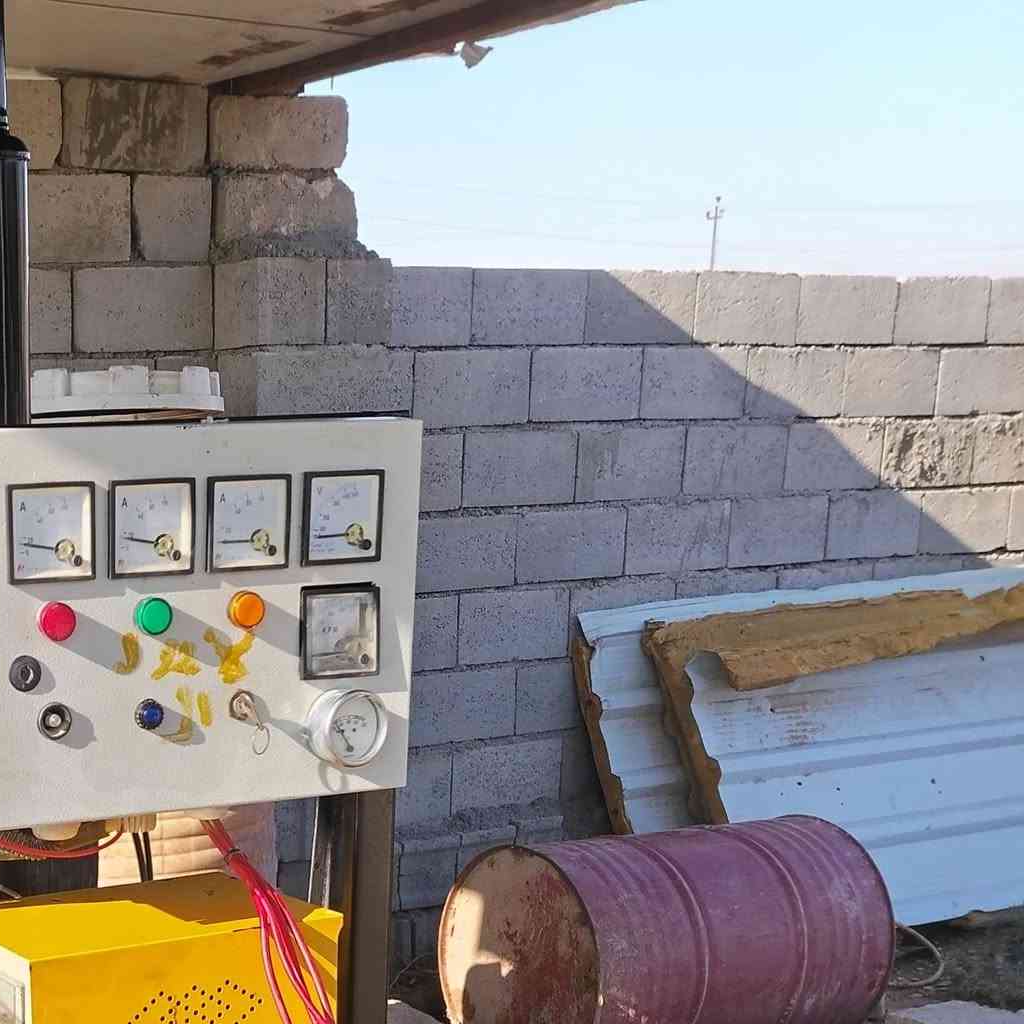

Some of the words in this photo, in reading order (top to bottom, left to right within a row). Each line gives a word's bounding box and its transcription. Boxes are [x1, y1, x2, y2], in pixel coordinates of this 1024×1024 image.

[121, 496, 128, 507] A
[218, 493, 226, 503] A
[19, 501, 26, 511] A
